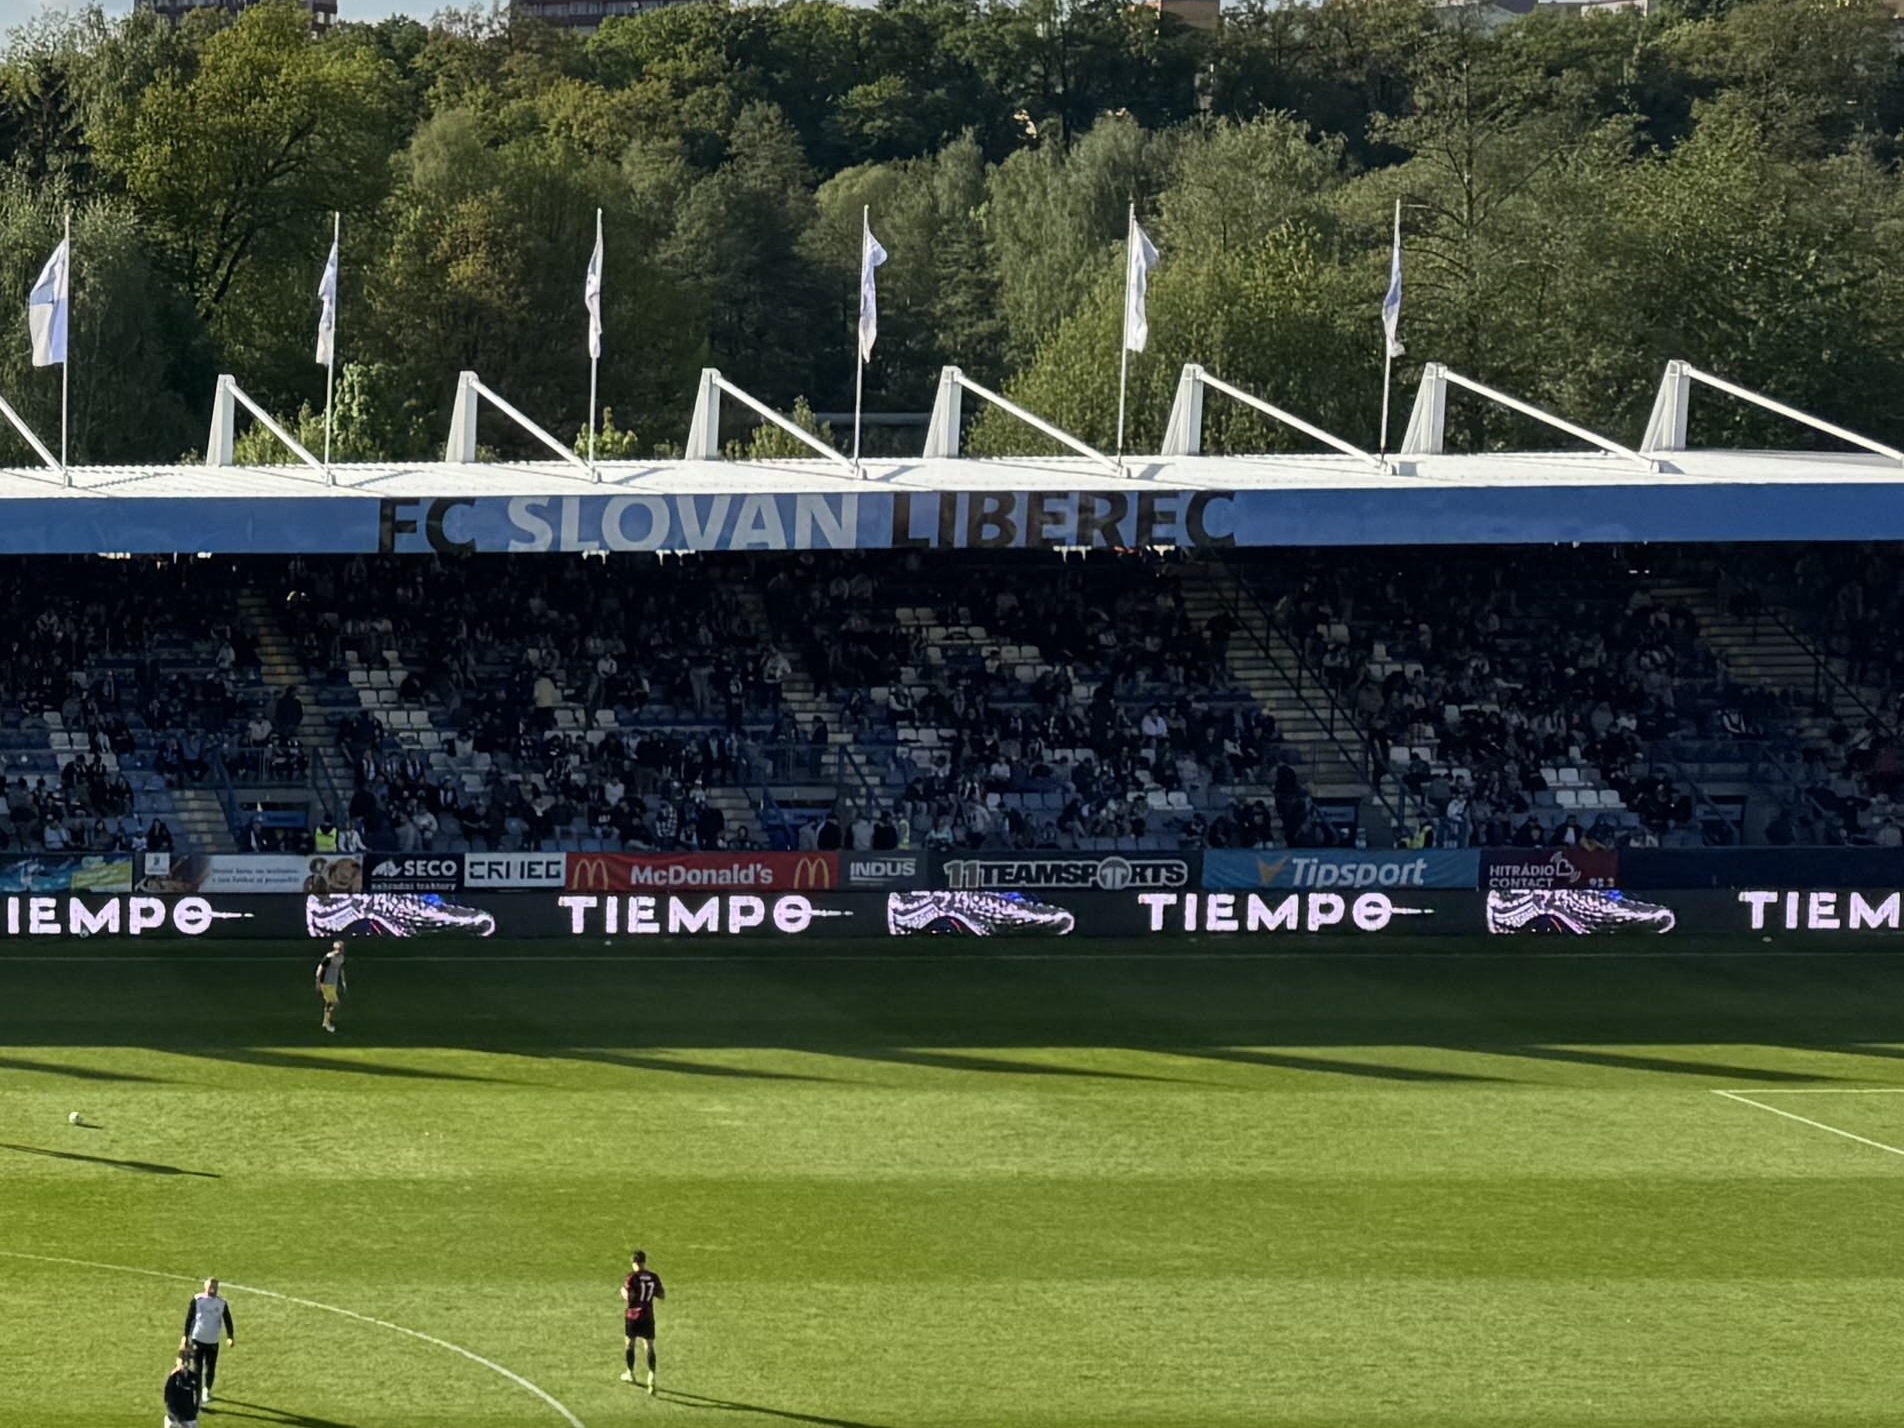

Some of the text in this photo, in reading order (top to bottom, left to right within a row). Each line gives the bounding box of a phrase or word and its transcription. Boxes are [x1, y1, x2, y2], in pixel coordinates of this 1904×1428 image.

[378, 490, 1237, 553] FC SLOVAN LIBEREC
[404, 860, 458, 877] SECO
[630, 863, 774, 886] McDonald's
[850, 861, 916, 876] INDUS
[1292, 858, 1427, 888] Tipsport
[1489, 863, 1555, 876] HITRÁDIO
[1489, 877, 1555, 888] CONTACT
[558, 895, 812, 933] TIEMPO
[1138, 892, 1392, 932] TIEMPO
[639, 1281, 655, 1302] 17
